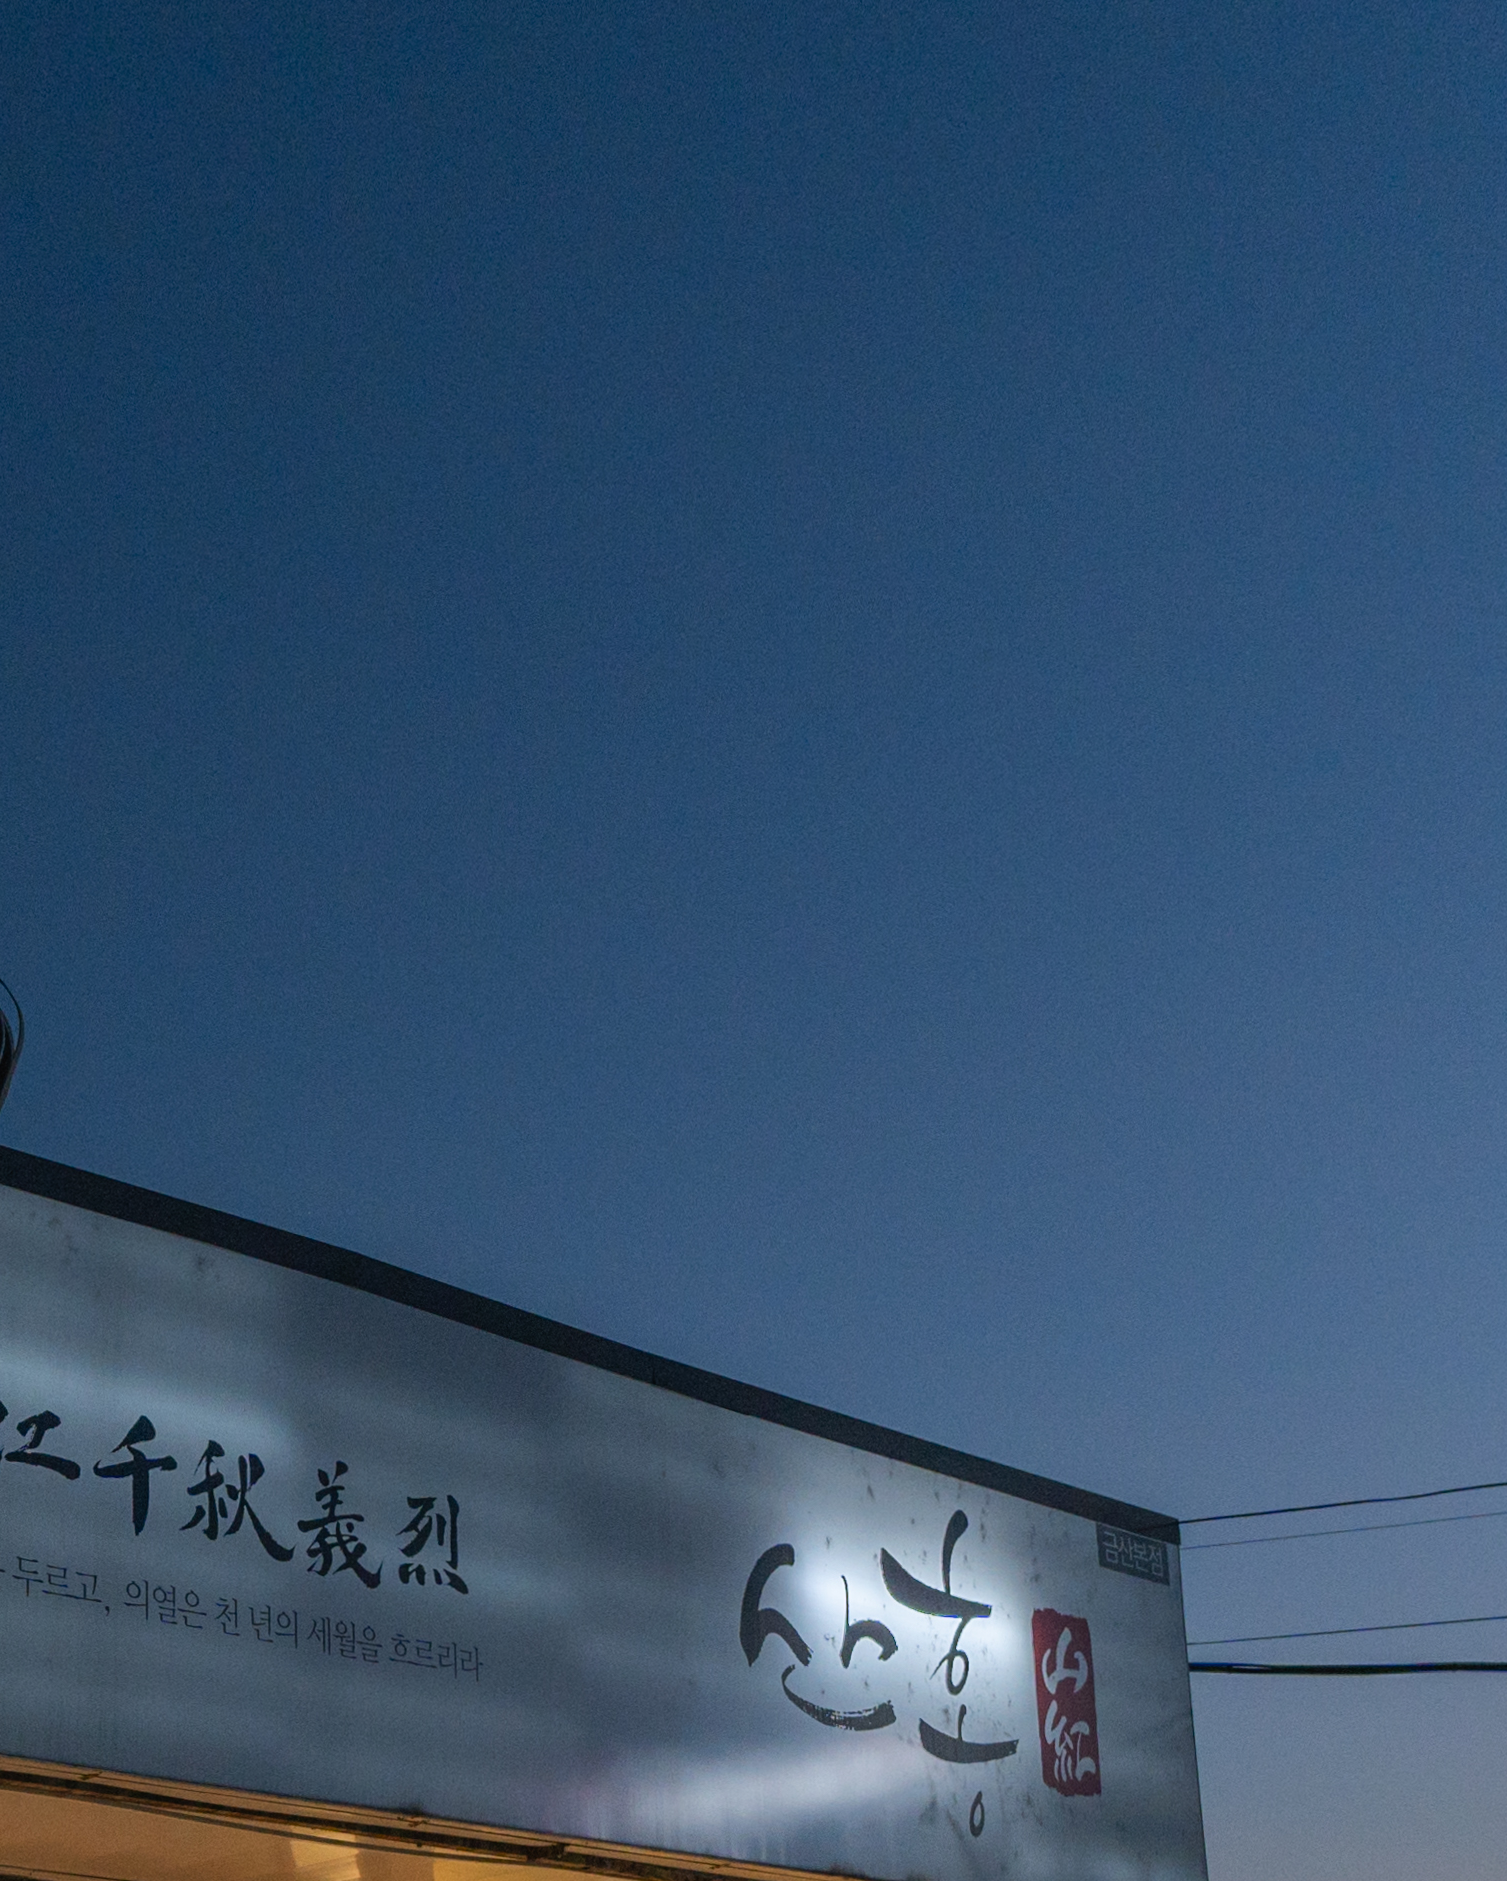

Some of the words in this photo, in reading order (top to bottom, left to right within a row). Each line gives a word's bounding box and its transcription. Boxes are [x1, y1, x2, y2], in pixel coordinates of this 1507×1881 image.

[1102, 1530, 1164, 1572] 금산본점
[12, 1556, 111, 1616] 두르고,
[124, 1580, 207, 1630] 의열은
[215, 1597, 240, 1636] 천
[249, 1606, 299, 1649] 년의
[307, 1617, 383, 1663] 세월을
[390, 1634, 483, 1682] 흐르리라
